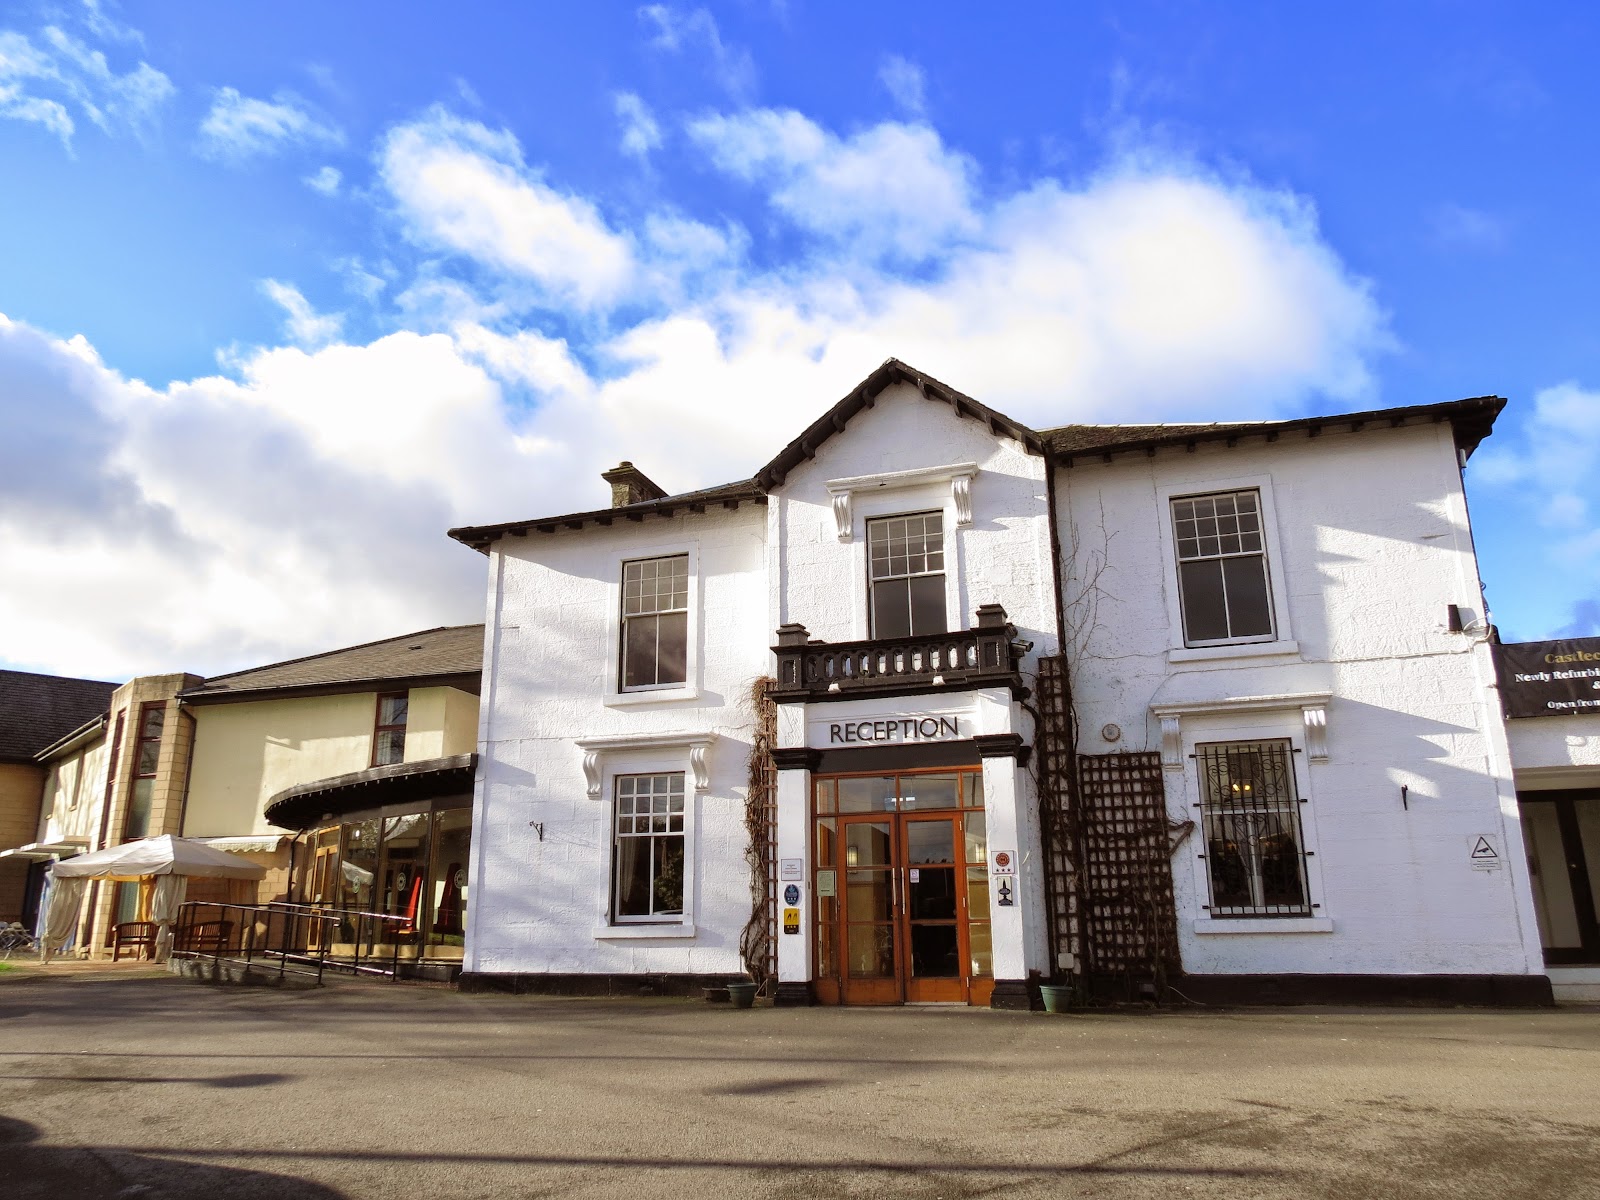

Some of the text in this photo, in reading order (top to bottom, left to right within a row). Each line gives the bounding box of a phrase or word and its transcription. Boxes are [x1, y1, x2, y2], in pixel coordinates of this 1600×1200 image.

[1515, 672, 1550, 682] Newly
[1547, 701, 1576, 709] Open
[830, 717, 959, 743] RECEPTION
